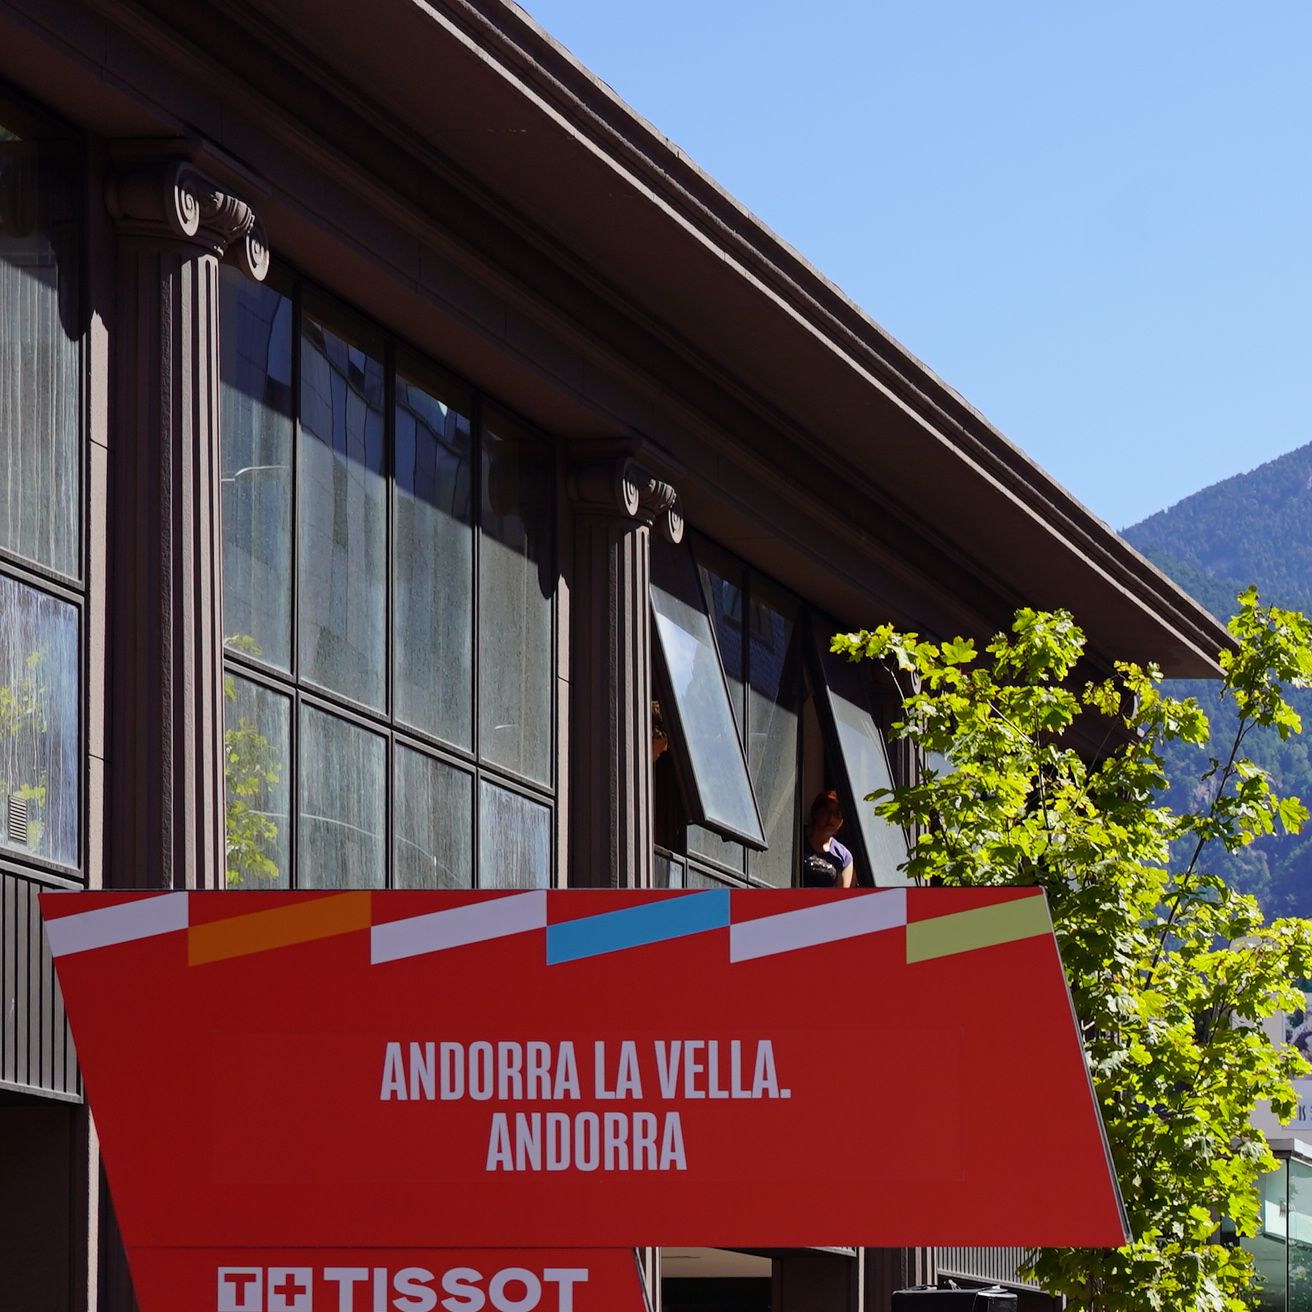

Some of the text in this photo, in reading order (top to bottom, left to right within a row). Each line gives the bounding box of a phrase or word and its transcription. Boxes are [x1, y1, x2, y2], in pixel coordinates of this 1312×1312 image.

[381, 1040, 791, 1100] ANDORRA LA VELLA.
[487, 1112, 686, 1171] ANDORRA
